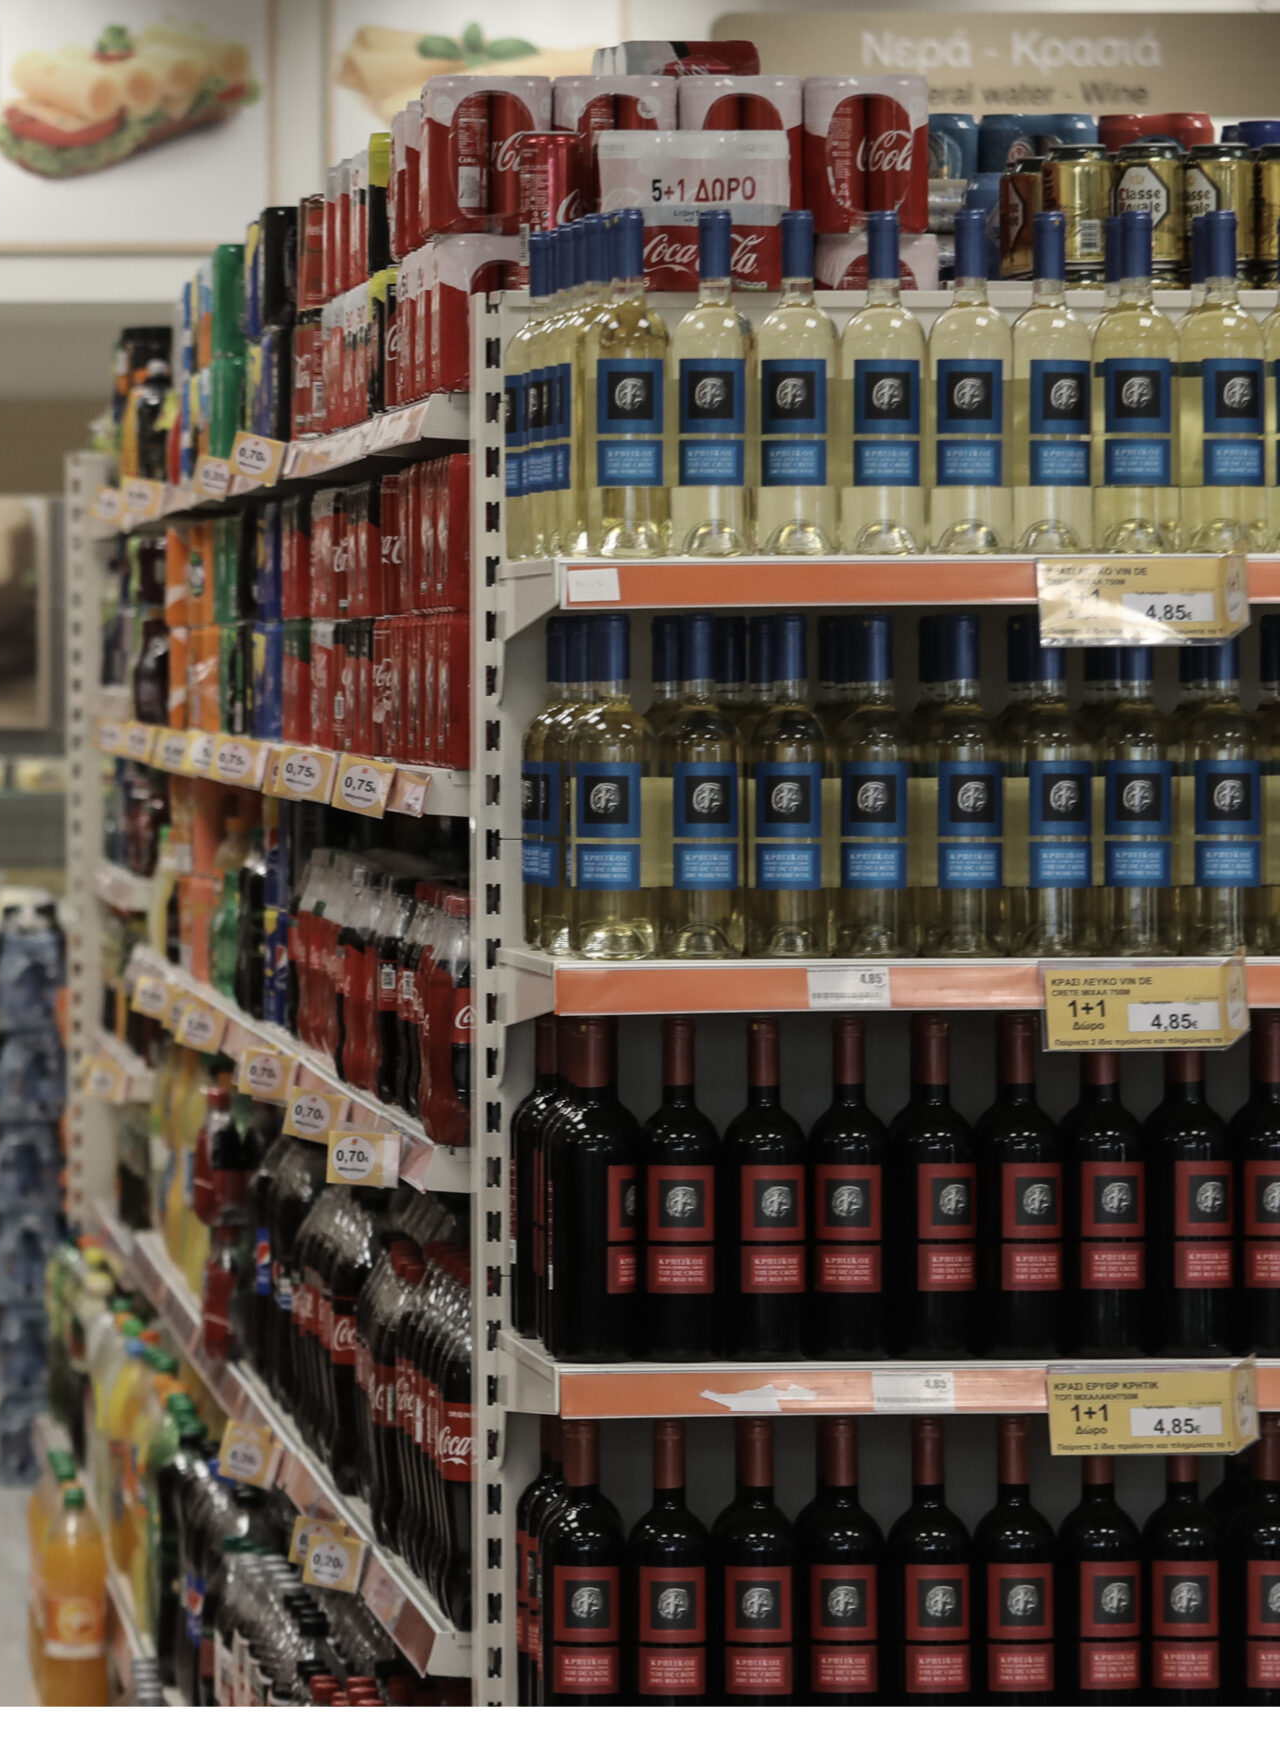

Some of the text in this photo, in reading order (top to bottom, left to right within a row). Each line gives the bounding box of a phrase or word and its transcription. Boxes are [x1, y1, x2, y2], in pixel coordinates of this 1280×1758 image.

[860, 27, 973, 72] Νερά
[1011, 28, 1161, 77] Κρασιά
[928, 81, 974, 106] eral
[981, 83, 1055, 106] water
[1079, 82, 1149, 106] Wine
[651, 176, 757, 202] 5+1 ΔΩΡΟ
[1138, 977, 1152, 985] DE
[1068, 1000, 1106, 1018] 1+1
[1072, 1021, 1105, 1031] Δώρο
[1151, 1013, 1199, 1032] 4,85€
[1053, 1383, 1083, 1391] ΚΡΑΣΙ
[1122, 1381, 1159, 1389] ΚΡΗΤΙΚ
[1070, 1403, 1109, 1422] 1+1
[1075, 1426, 1108, 1436] Δώρο
[1153, 1418, 1201, 1436] 4,85€
